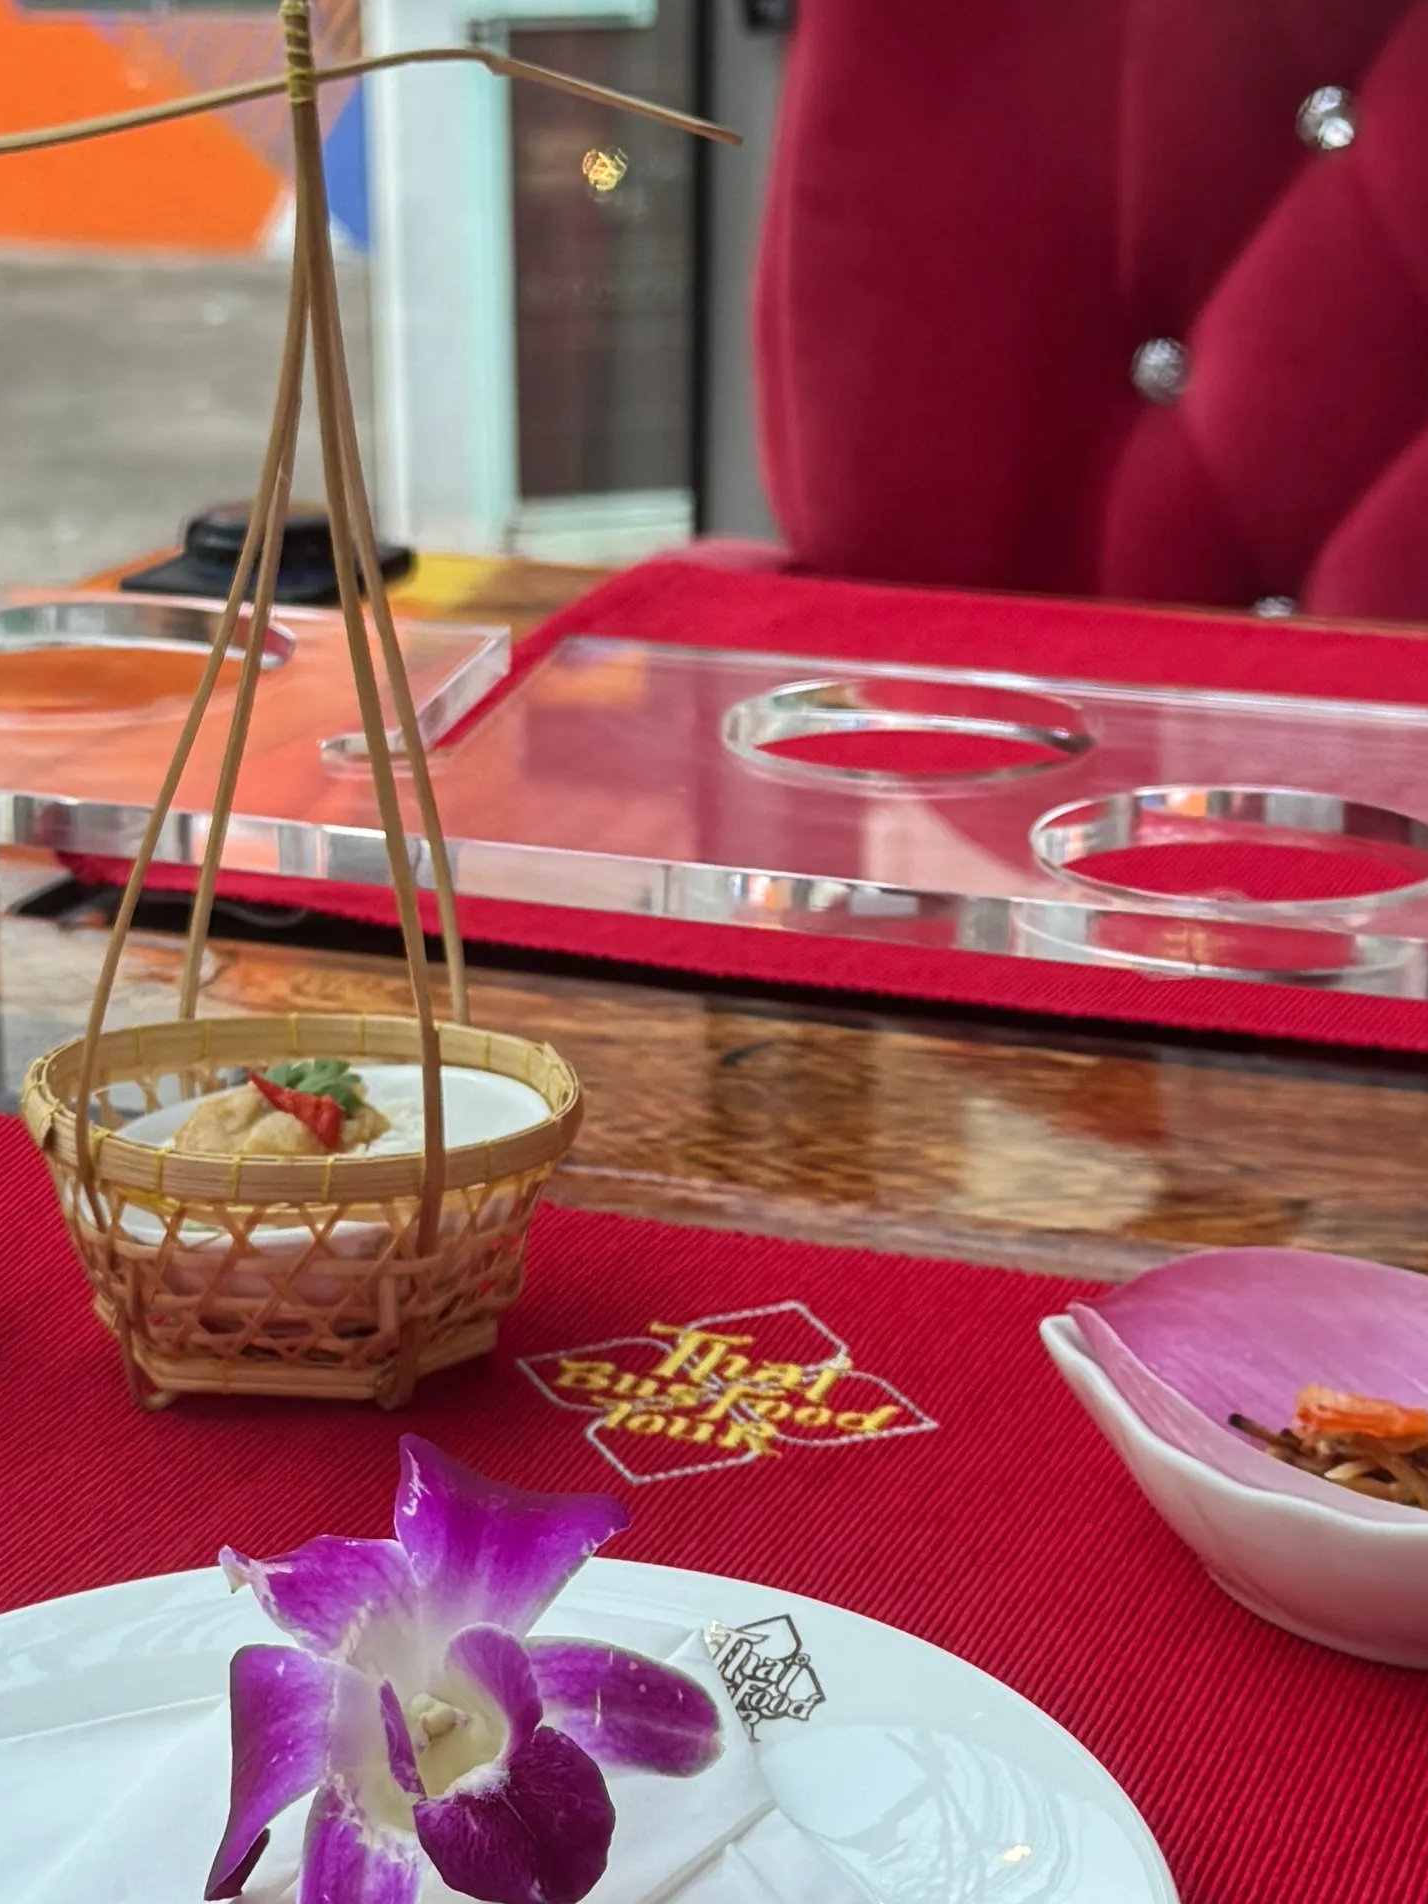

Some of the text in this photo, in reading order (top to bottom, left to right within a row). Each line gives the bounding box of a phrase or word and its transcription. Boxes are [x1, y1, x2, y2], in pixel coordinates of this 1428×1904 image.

[555, 1357, 899, 1436] Bus Food
[649, 1321, 853, 1402] Thai
[712, 1628, 811, 1696] Thai
[734, 1678, 823, 1722] Food
